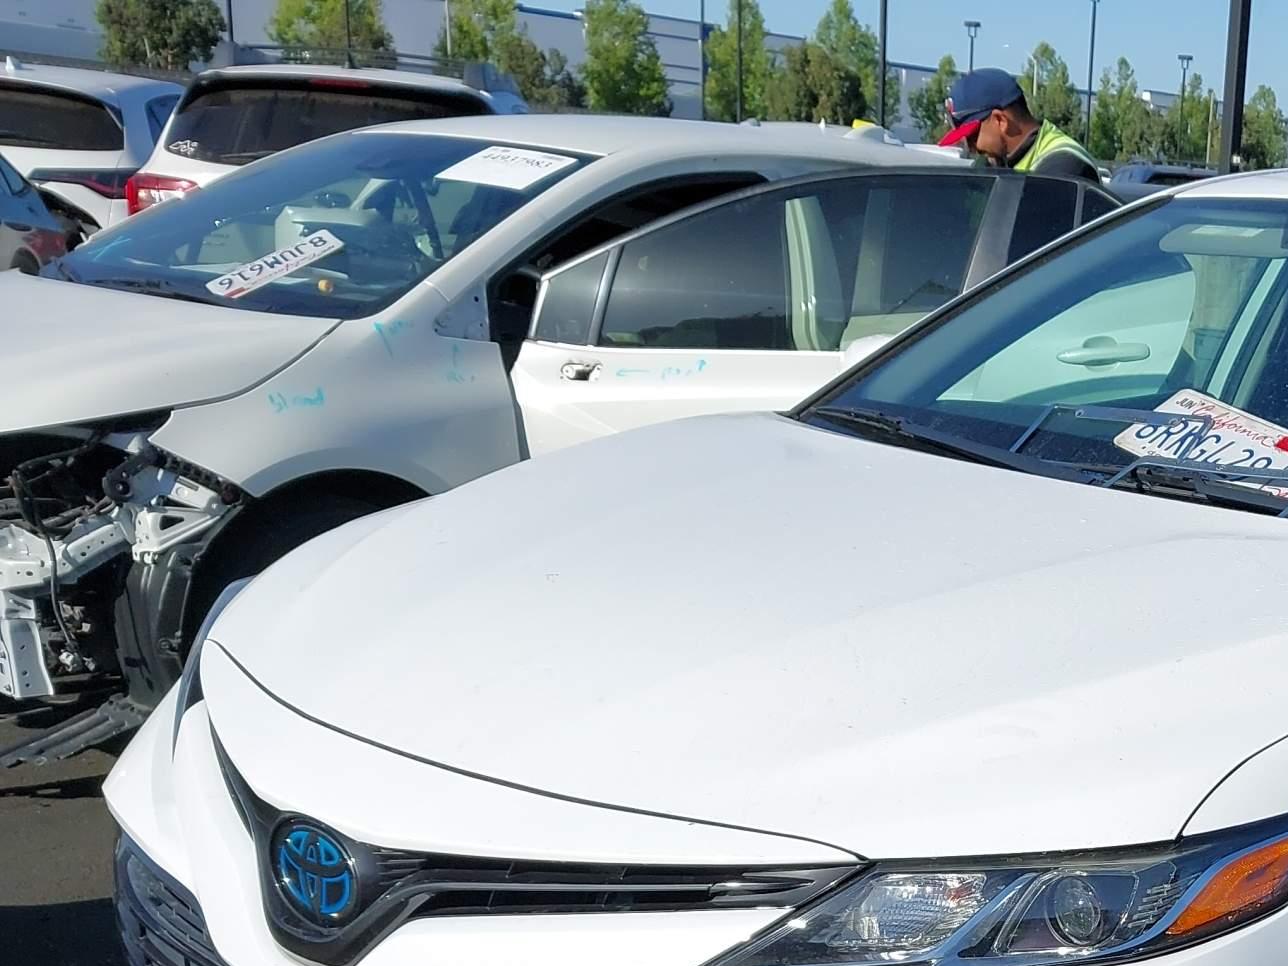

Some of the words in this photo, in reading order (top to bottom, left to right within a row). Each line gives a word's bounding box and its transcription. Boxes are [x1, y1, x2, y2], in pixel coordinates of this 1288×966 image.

[218, 235, 328, 290] 8JUM616
[1175, 397, 1198, 410] JUN
[1191, 404, 1276, 448] Clifornia
